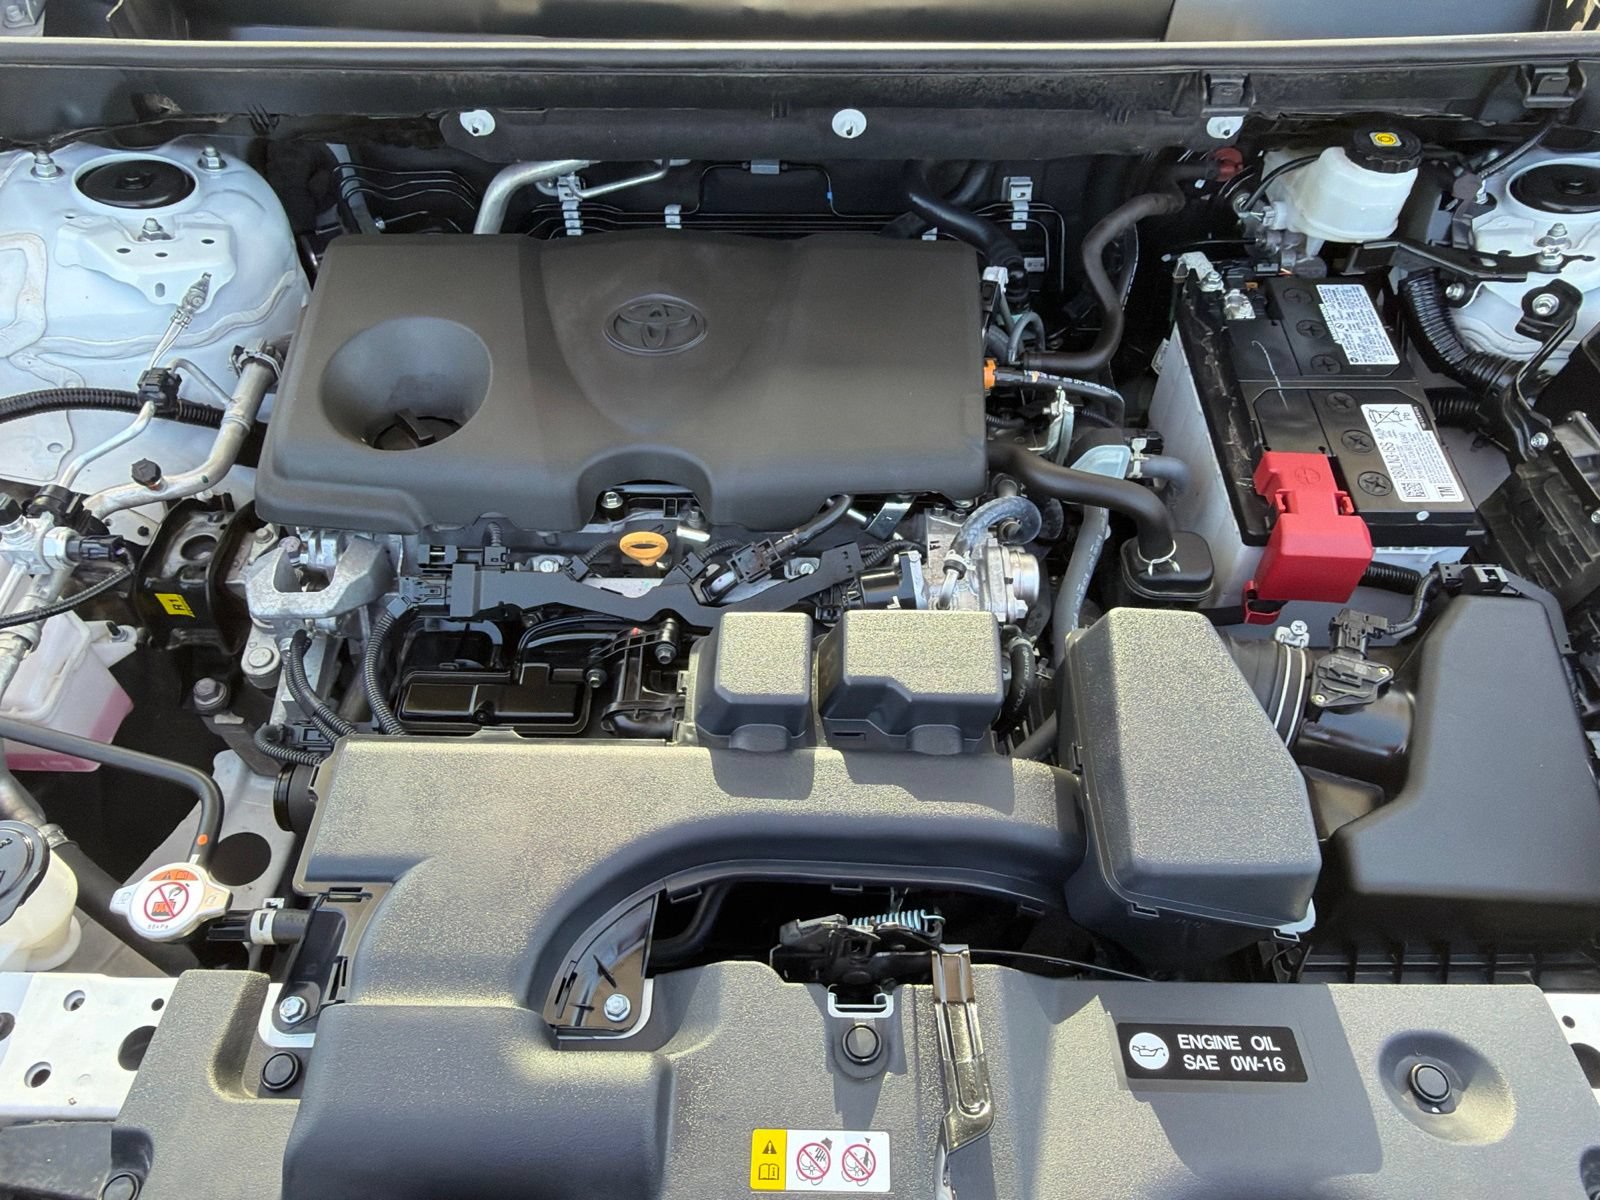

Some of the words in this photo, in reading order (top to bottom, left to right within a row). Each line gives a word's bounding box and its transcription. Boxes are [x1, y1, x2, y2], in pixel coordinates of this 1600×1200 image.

[1438, 487, 1456, 497] TM
[1178, 1034, 1242, 1050] ENGINE
[1251, 1036, 1281, 1051] OIL
[1183, 1055, 1220, 1070] SAE
[1230, 1056, 1286, 1072] 0W-16
